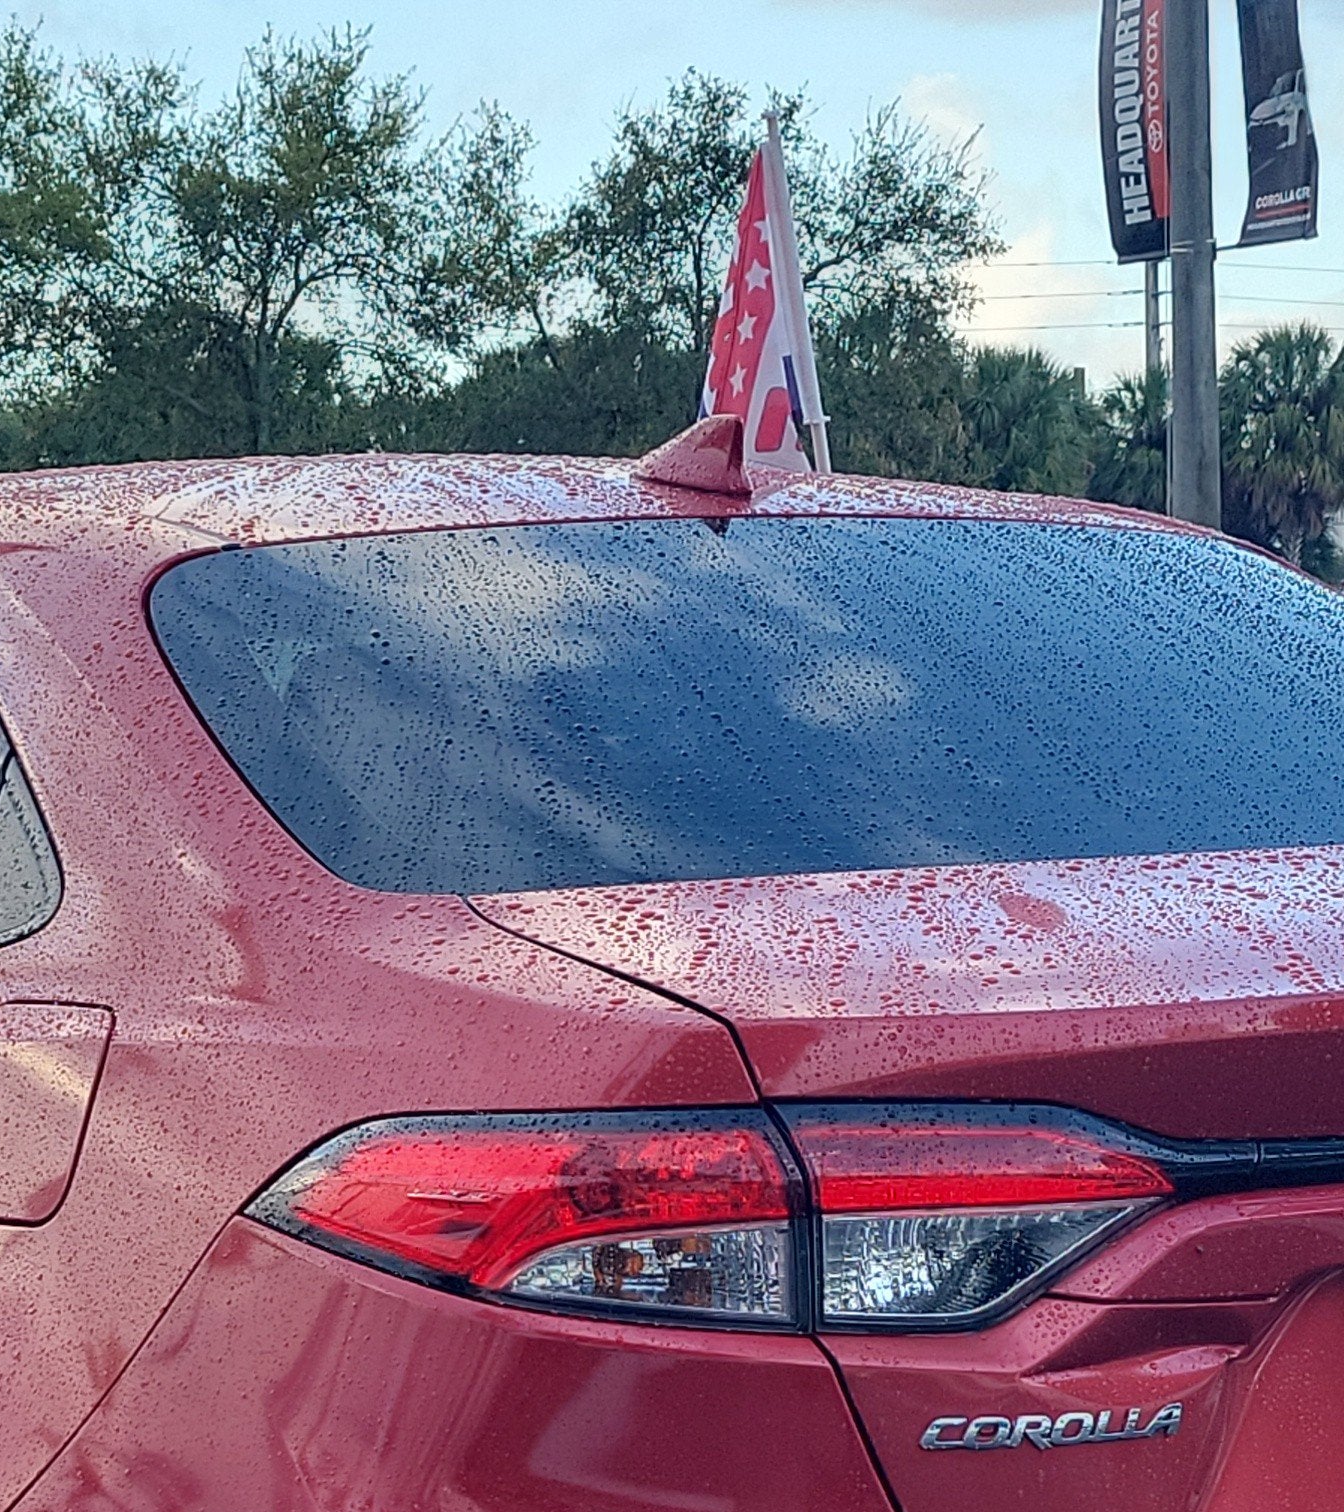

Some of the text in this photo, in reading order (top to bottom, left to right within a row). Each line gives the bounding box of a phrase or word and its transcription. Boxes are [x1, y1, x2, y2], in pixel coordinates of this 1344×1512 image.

[1113, 0, 1153, 226] HEADQUART
[1146, 10, 1160, 118] TOYOTA
[918, 1402, 1183, 1450] COROLLA
